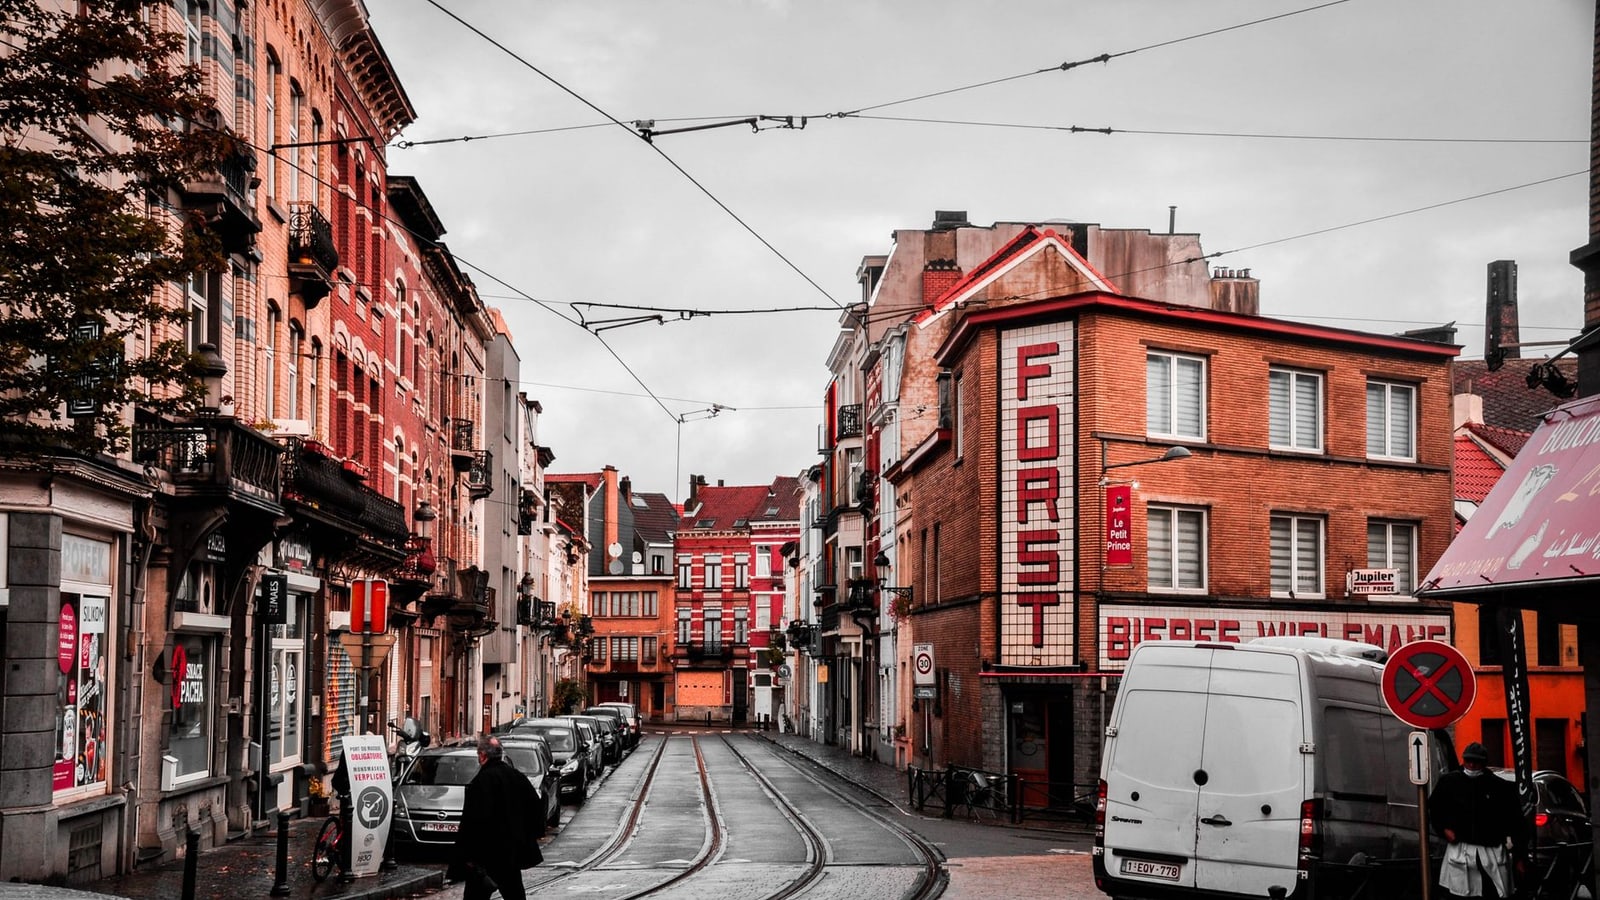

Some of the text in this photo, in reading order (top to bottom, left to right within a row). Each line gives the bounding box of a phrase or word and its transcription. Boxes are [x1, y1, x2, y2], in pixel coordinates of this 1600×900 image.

[1017, 342, 1059, 648] FORST
[1114, 518, 1124, 528] Le
[1110, 529, 1127, 539] Petit
[1107, 541, 1130, 550] Prince
[1354, 571, 1394, 583] Jupiler
[919, 659, 929, 668] 30
[180, 681, 204, 703] PACHA
[354, 773, 386, 781] VERPLICHT
